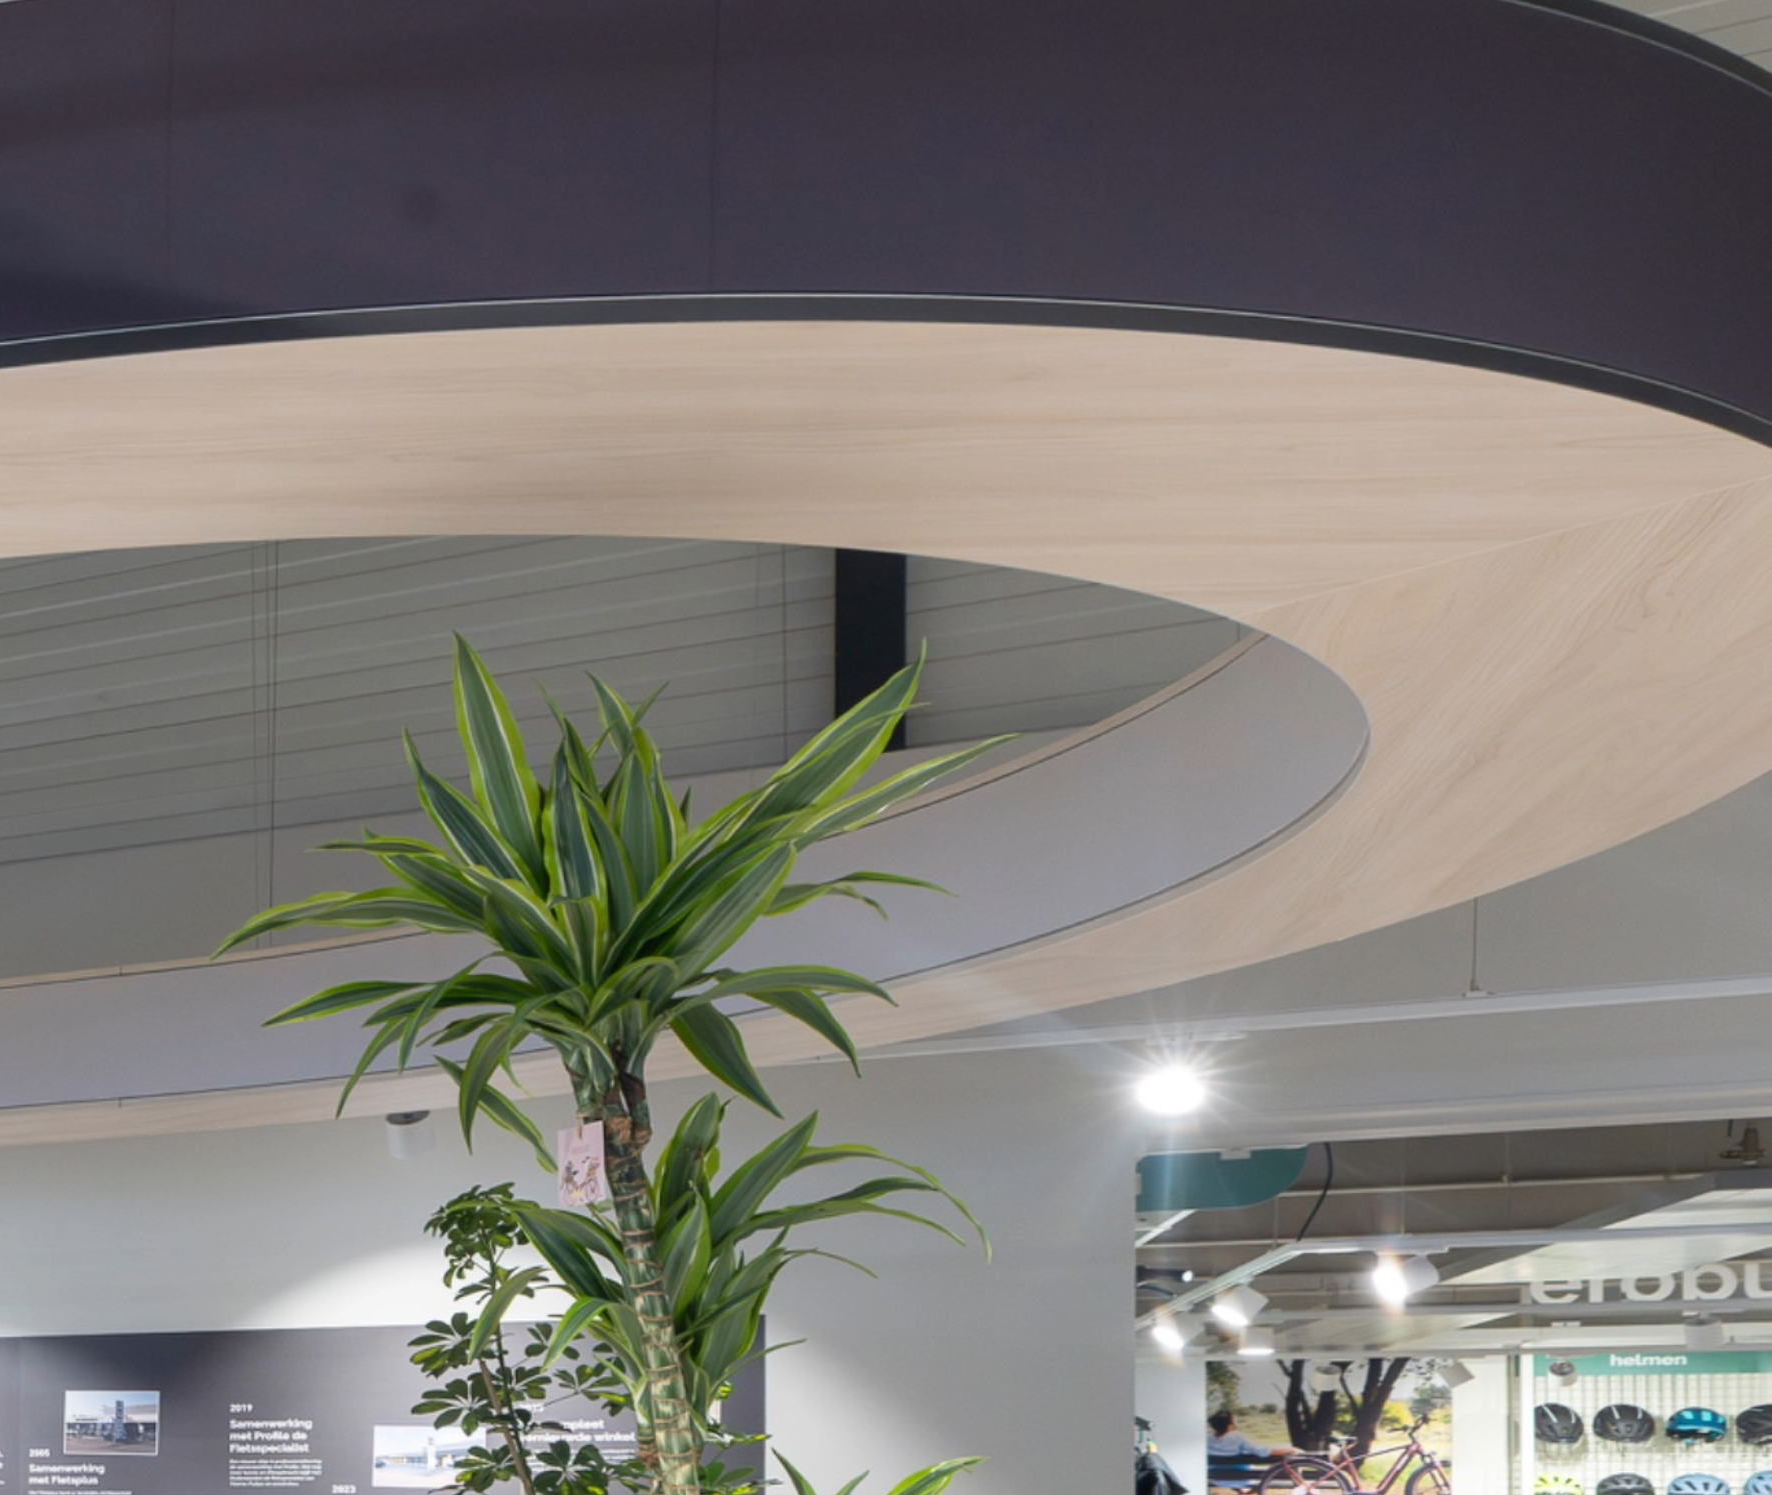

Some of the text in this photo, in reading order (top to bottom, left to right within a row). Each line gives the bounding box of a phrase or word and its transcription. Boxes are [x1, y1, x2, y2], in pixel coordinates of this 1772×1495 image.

[1609, 1353, 1688, 1367] helmen
[229, 1418, 312, 1430] Samenwerking
[229, 1431, 252, 1441] met
[291, 1430, 308, 1440] de
[29, 1463, 106, 1475] Samenwerking
[29, 1475, 49, 1485] met
